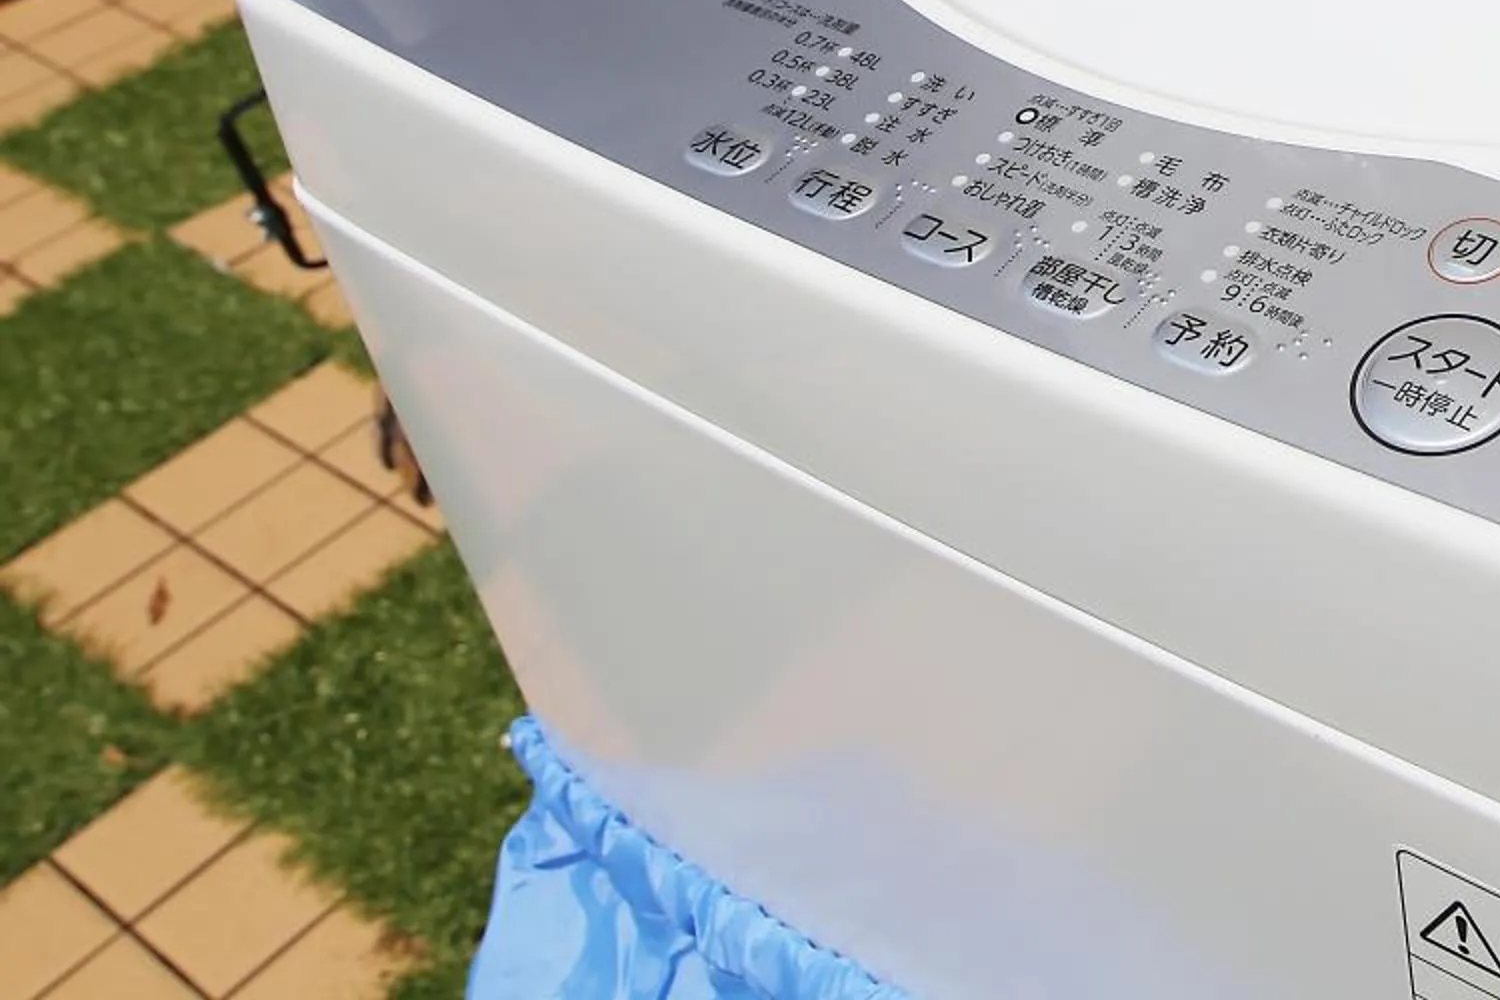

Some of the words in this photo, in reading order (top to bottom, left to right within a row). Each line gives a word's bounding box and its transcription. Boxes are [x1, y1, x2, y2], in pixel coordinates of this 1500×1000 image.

[825, 69, 859, 90] 38L
[851, 51, 882, 71] 48L
[801, 89, 836, 111] 23L
[902, 97, 957, 124] すすぎ
[690, 130, 762, 169] 水位
[794, 169, 872, 213] 行程
[963, 180, 1047, 220] おしゃれ着
[1130, 177, 1208, 215] 槽洗浄
[904, 213, 989, 263] コース
[1259, 225, 1347, 266] 衣類片寄り
[1451, 229, 1499, 266] 切
[1031, 256, 1125, 305] 部屋干し
[1238, 250, 1313, 288] 排水点検
[1032, 282, 1089, 315] 槽乾燥
[1165, 313, 1249, 368] 予約
[1373, 378, 1480, 433] 一時停止
